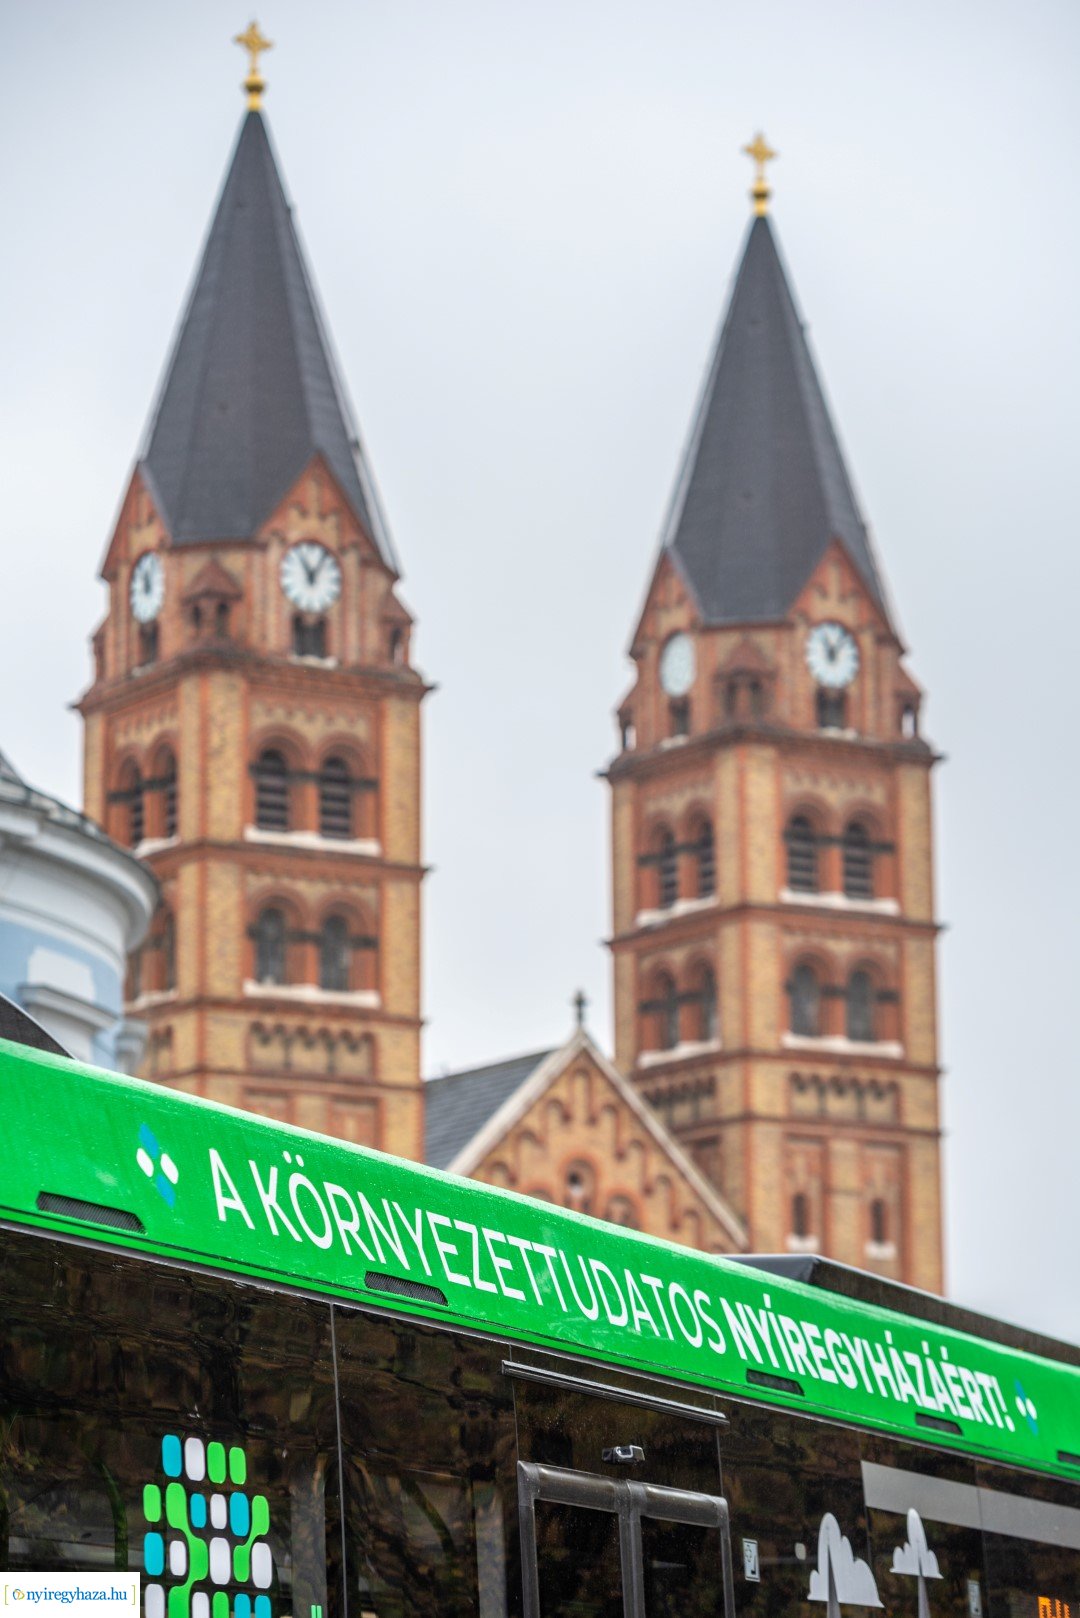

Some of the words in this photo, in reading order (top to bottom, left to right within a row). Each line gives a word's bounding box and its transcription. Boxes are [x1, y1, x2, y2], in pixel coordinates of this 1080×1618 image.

[208, 1148, 256, 1230] A
[249, 1150, 727, 1355] KÖRNYEZETTUDATOS
[720, 1293, 1015, 1432] NYÍREGYHÁZÁÉRT!
